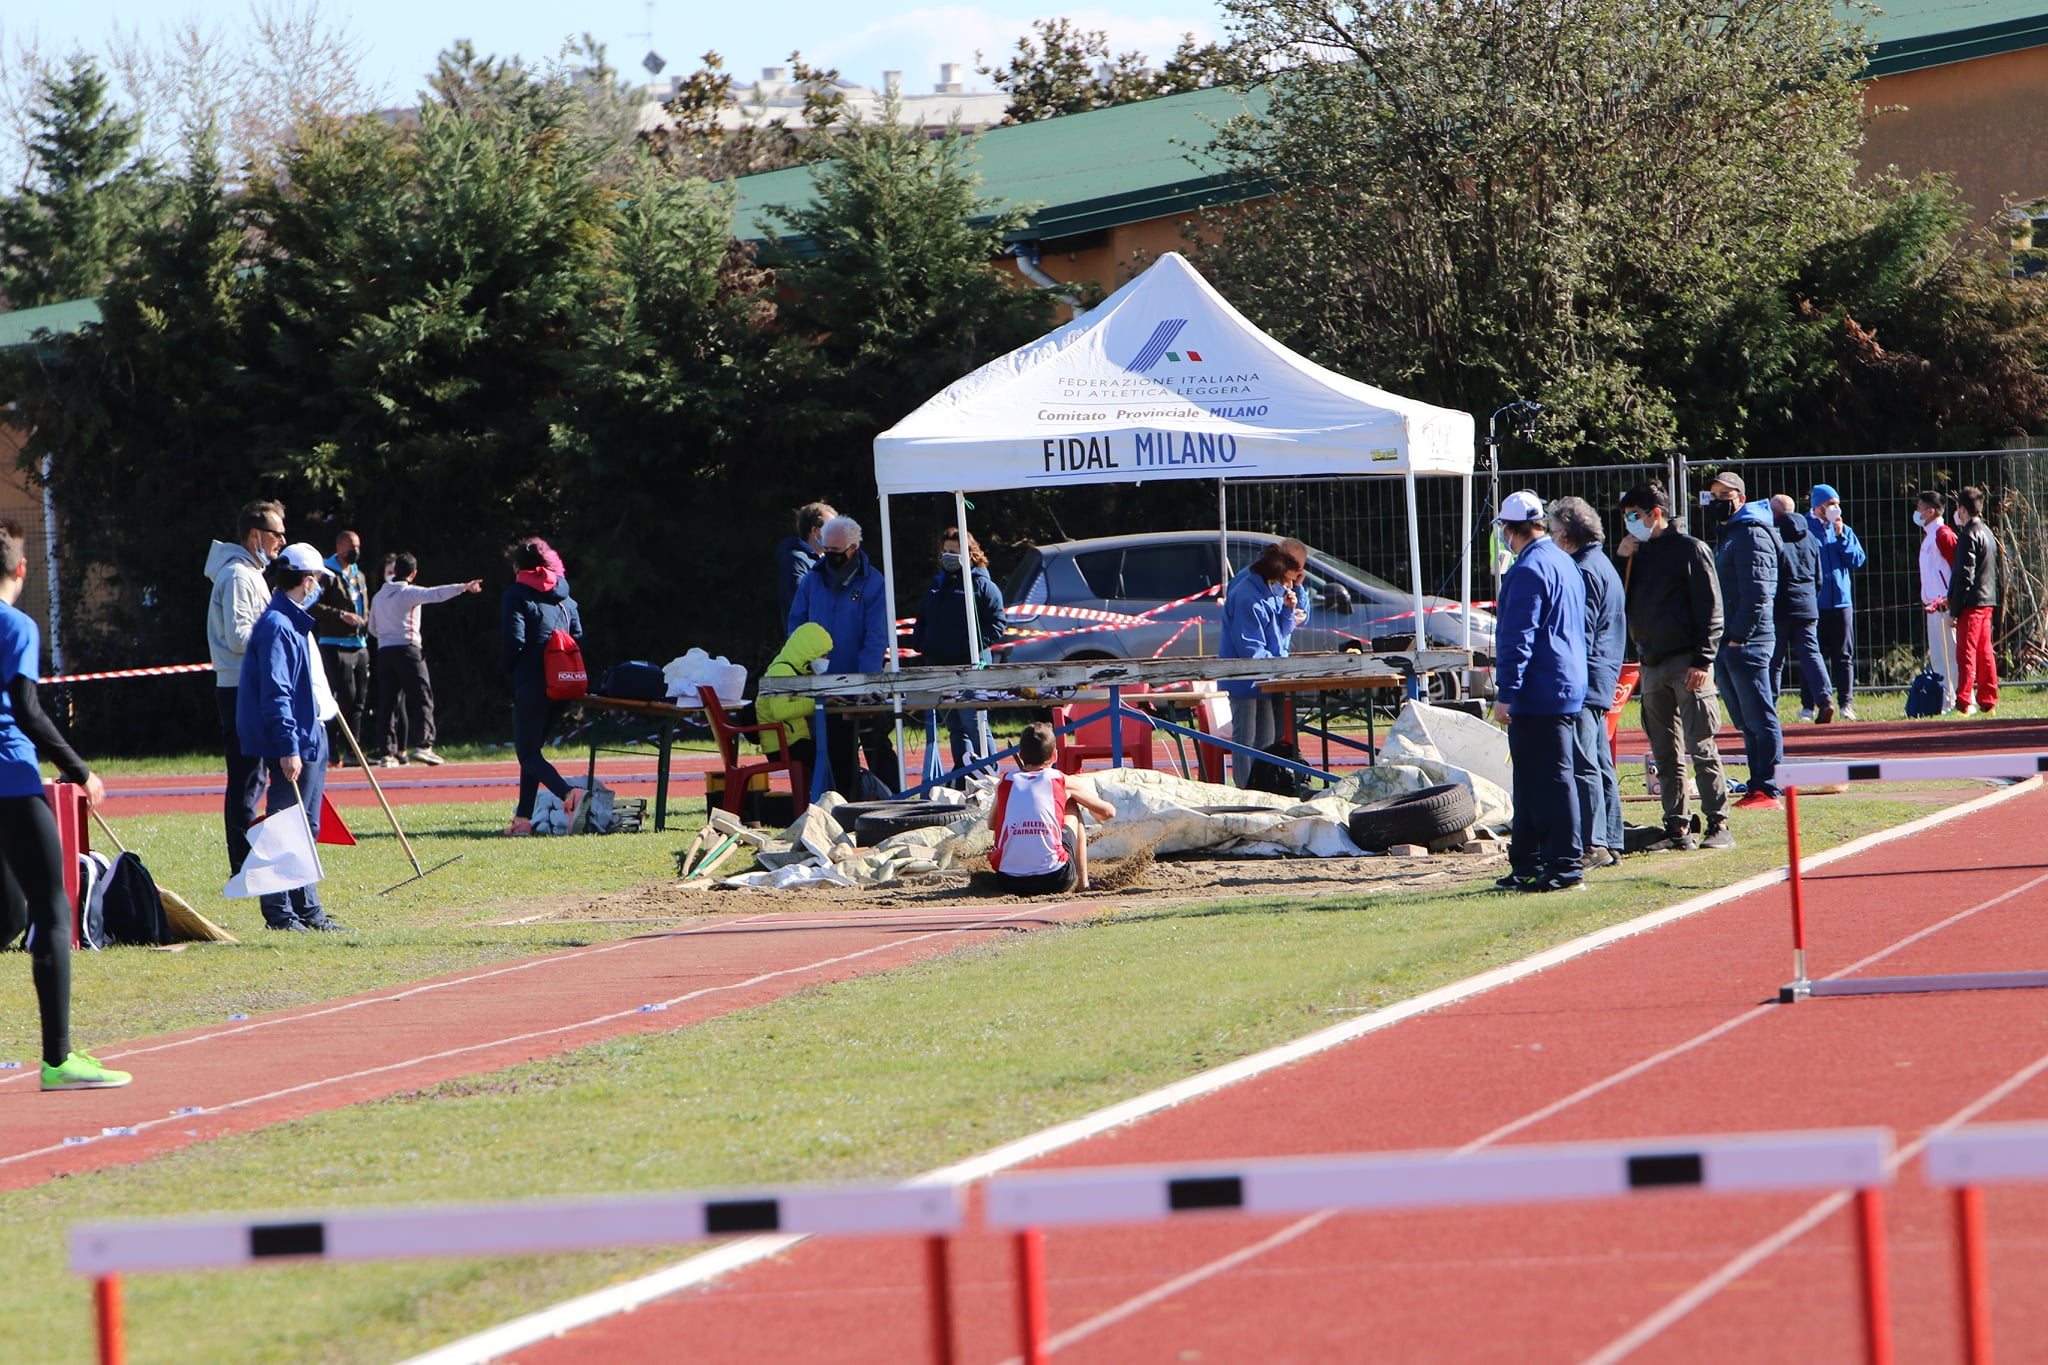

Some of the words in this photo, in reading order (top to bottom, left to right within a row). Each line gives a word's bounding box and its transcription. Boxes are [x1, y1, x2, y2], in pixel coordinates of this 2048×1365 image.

[1058, 376, 1175, 388] FEDERAZIONE
[1182, 373, 1260, 385] ITALIANA
[1063, 388, 1081, 398] DI
[1088, 388, 1169, 398] ATLETICA
[1177, 385, 1251, 396] LEGGERA
[1037, 409, 1107, 421] Comitato
[1116, 407, 1200, 420] Provinciale
[1209, 405, 1269, 418] MILANO
[1043, 435, 1119, 472] FIDAL
[1135, 431, 1237, 466] MILANO
